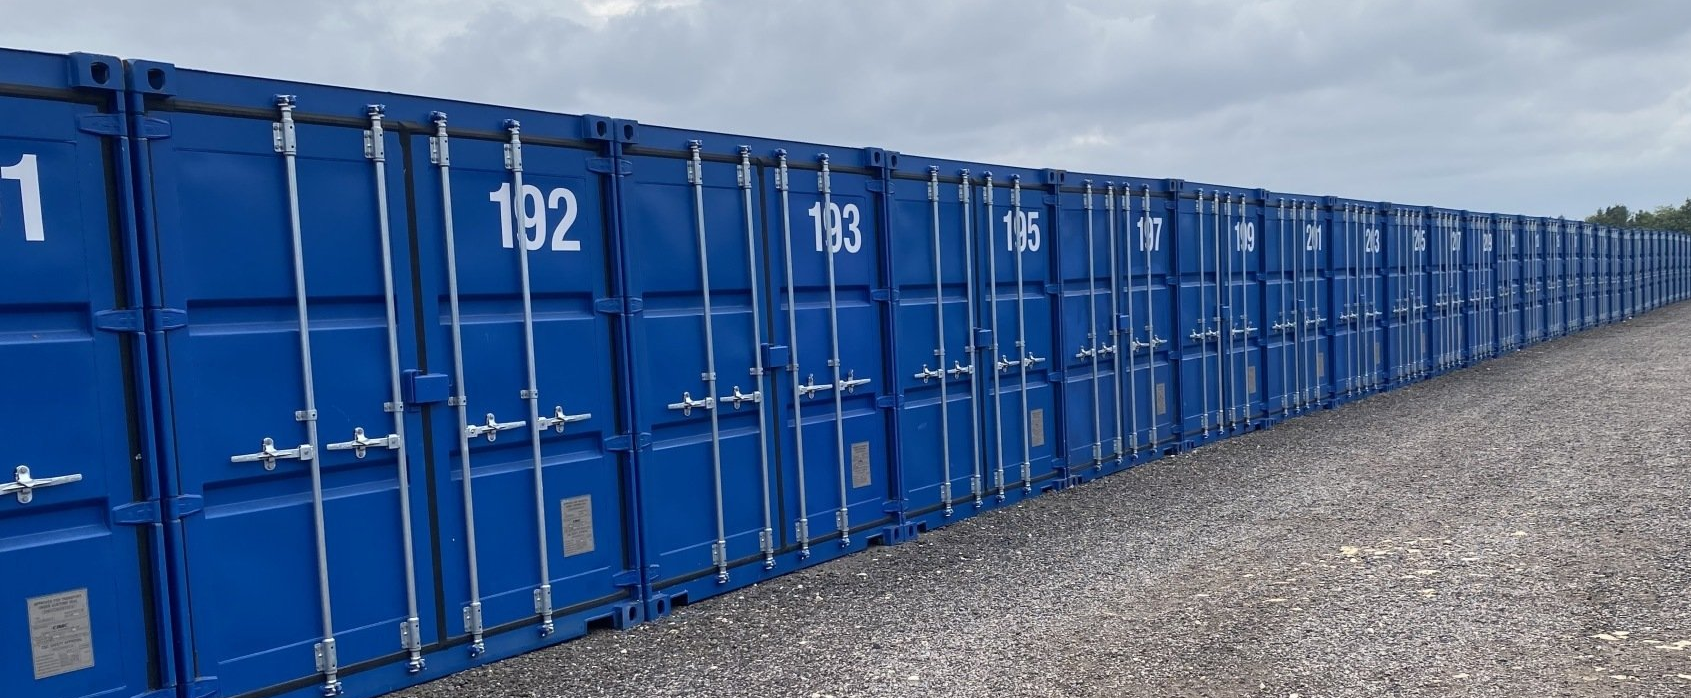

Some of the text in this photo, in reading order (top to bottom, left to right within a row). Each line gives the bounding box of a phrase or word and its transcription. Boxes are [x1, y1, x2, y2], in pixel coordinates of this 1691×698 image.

[489, 182, 581, 252] 192
[808, 201, 862, 253] 193
[1003, 210, 1041, 252] 195
[1136, 216, 1163, 252] 197
[1234, 221, 1255, 252] 199
